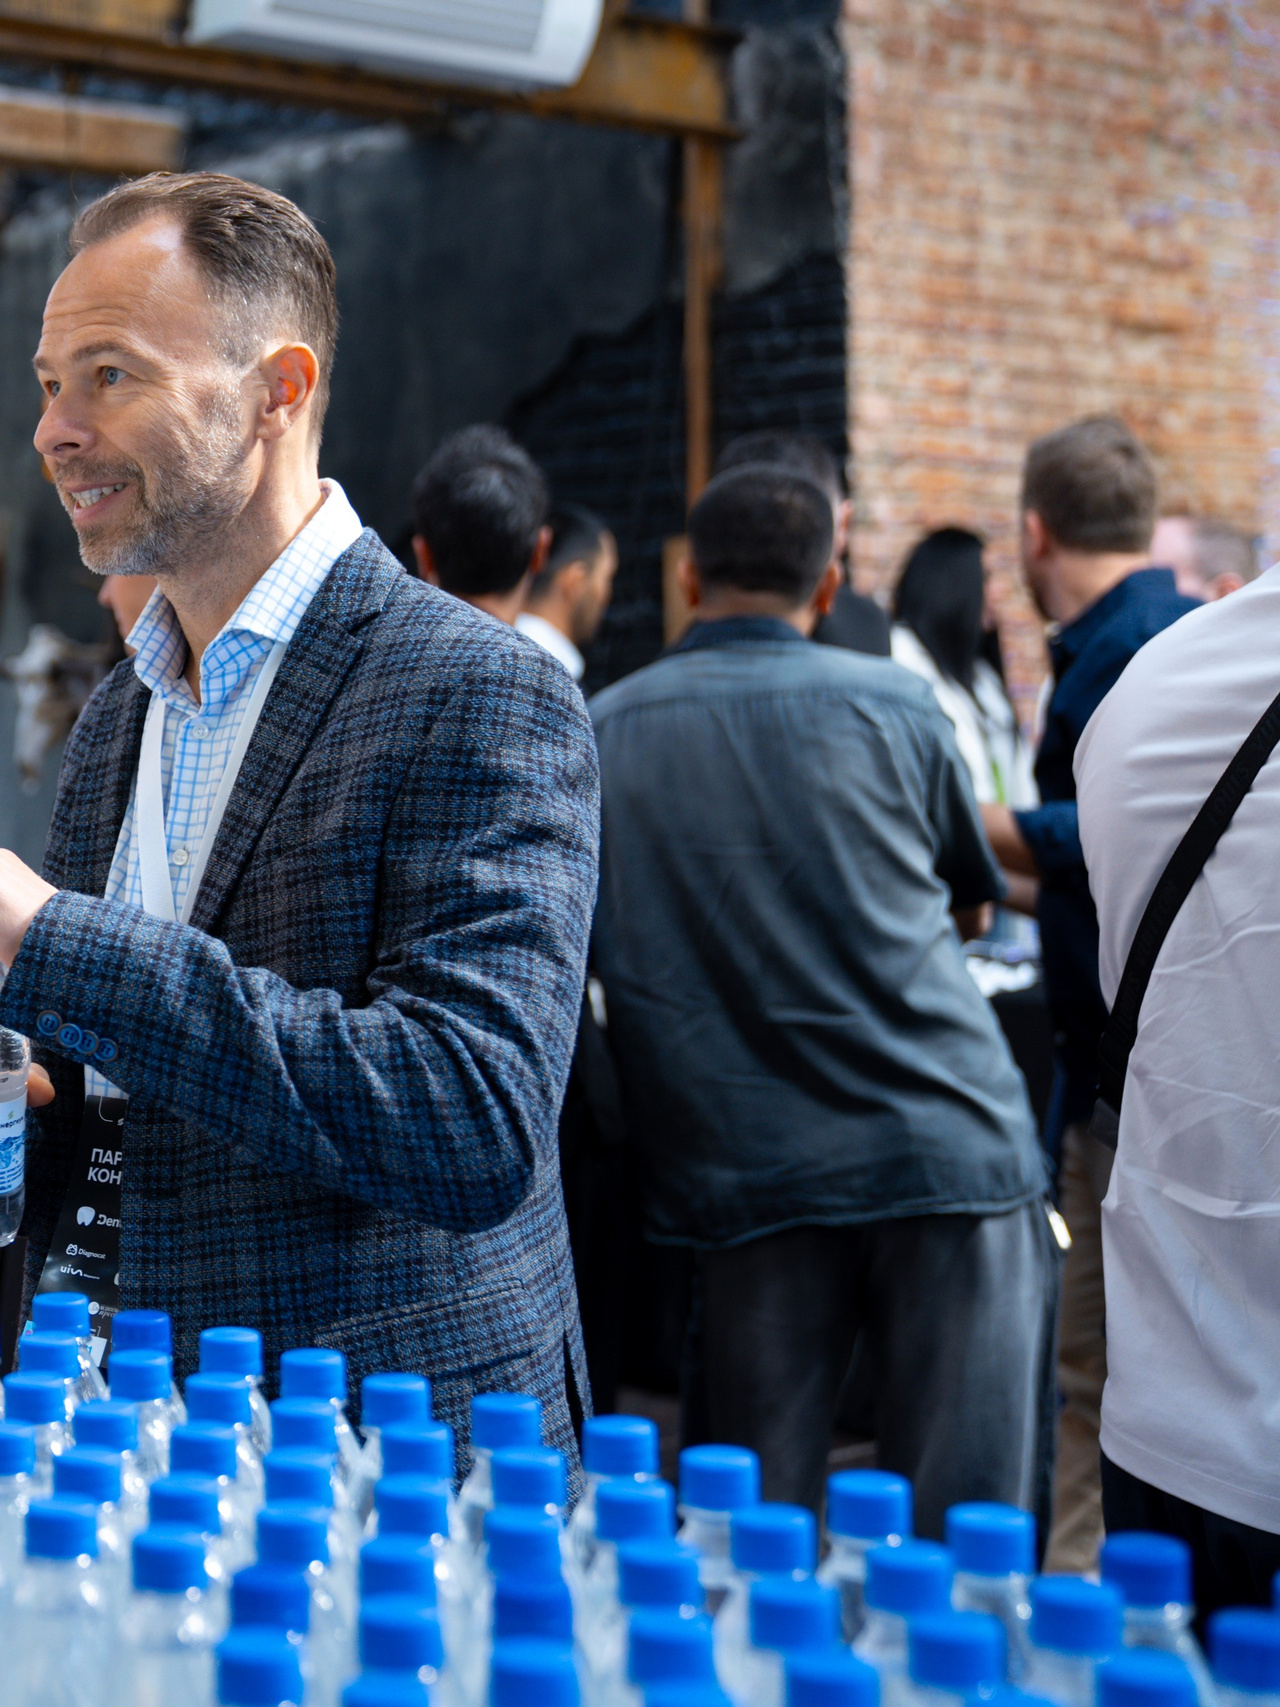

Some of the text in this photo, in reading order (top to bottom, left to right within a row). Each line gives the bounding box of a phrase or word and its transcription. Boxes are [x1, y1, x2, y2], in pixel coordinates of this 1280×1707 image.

[91, 1148, 123, 1166] ПАР
[87, 1166, 122, 1185] КОН
[78, 1248, 107, 1260] Diagnocat
